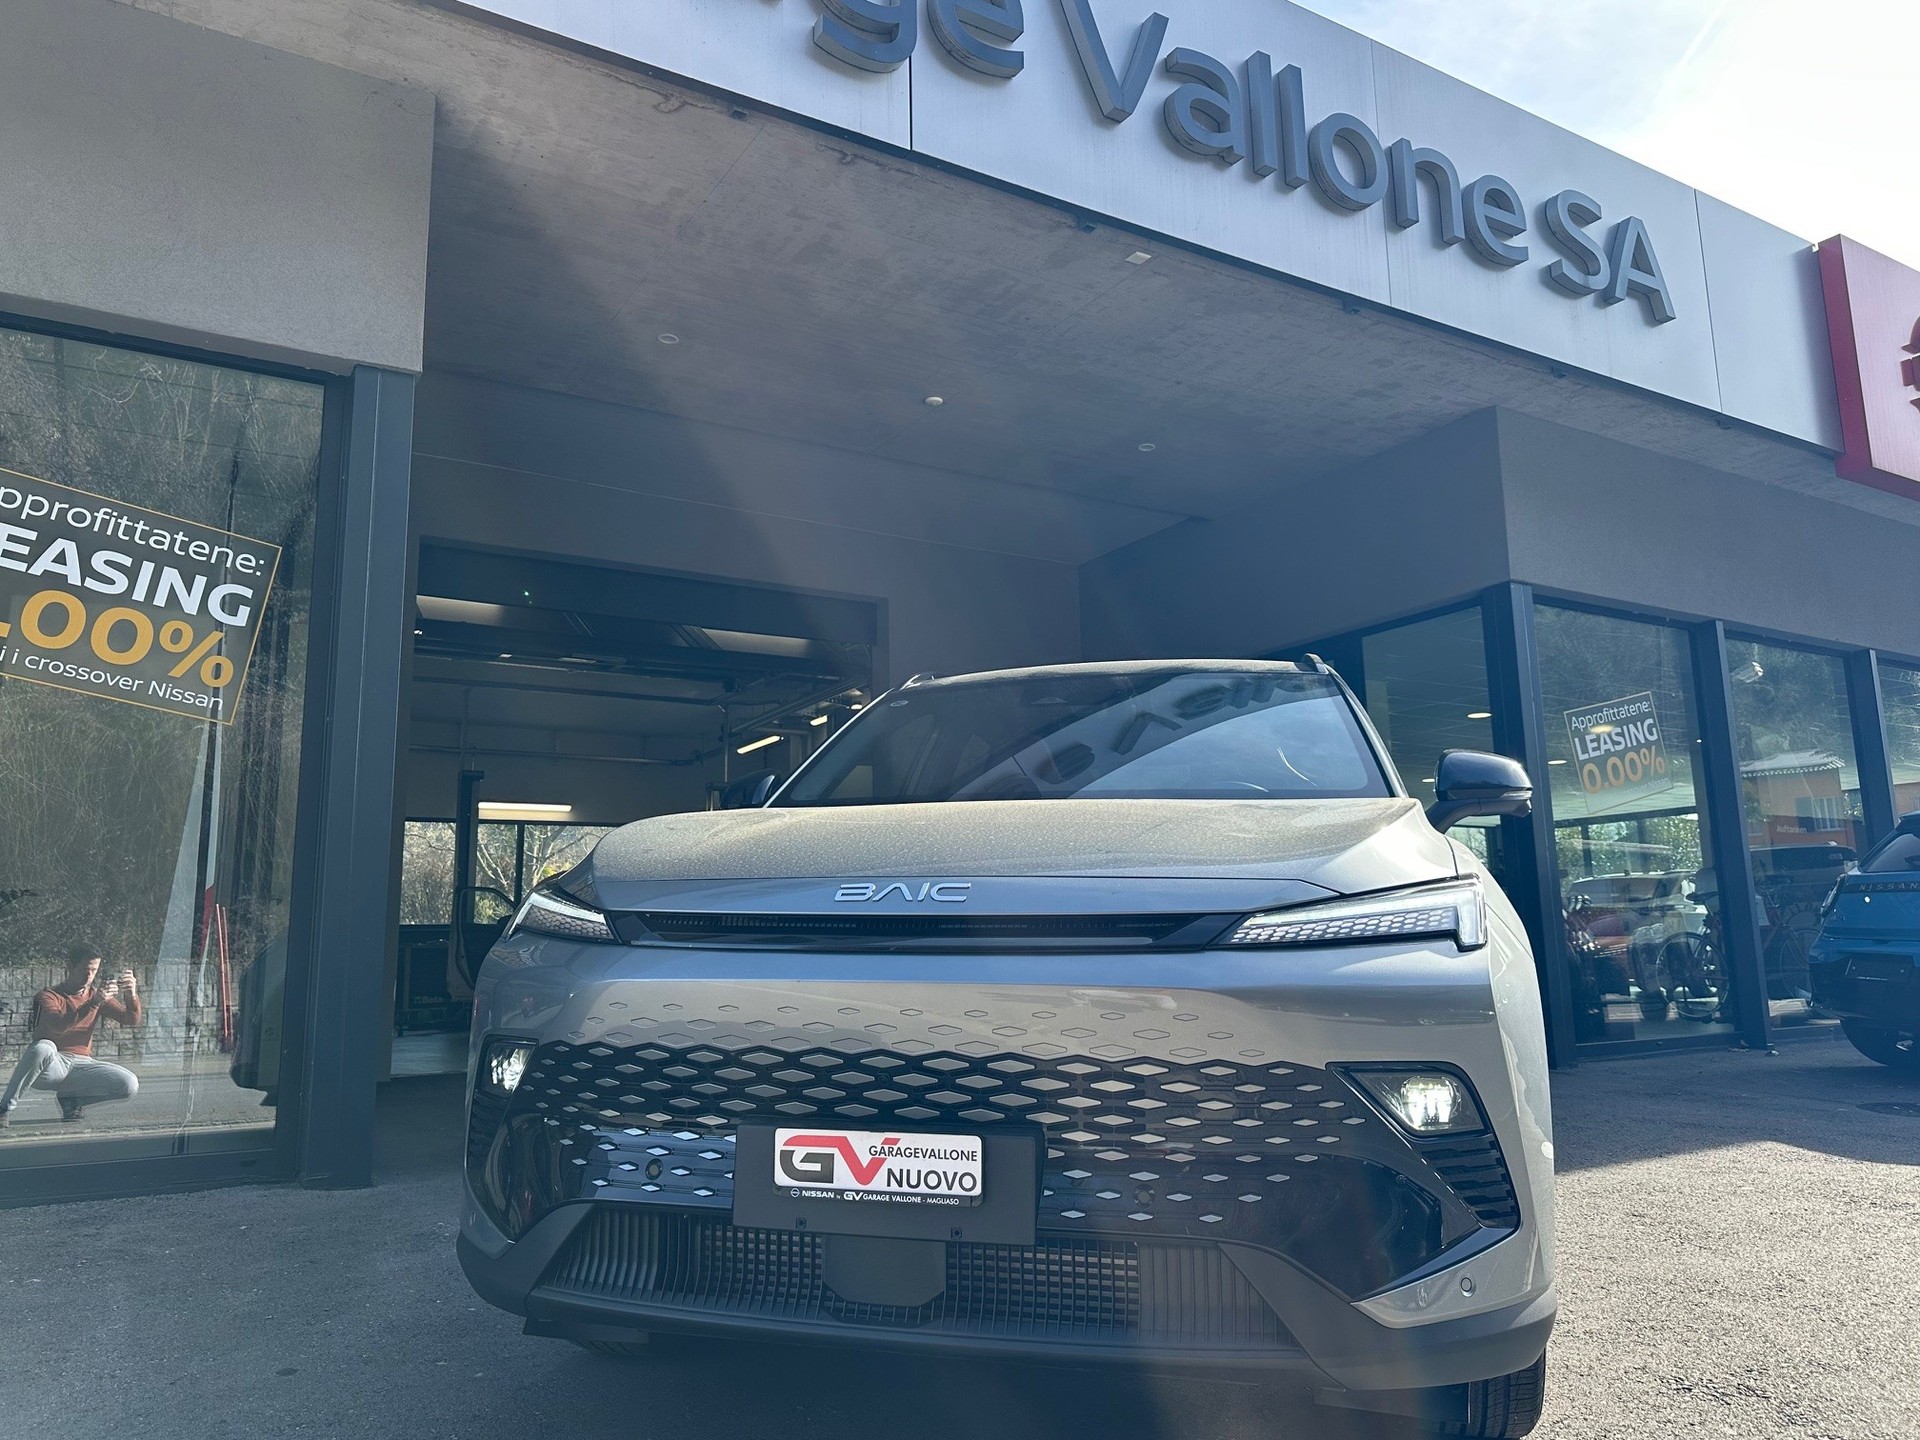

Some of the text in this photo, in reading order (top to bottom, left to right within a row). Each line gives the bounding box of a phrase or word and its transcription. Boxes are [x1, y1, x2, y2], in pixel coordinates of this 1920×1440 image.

[1058, 0, 1529, 267] Vallone
[1545, 189, 1676, 324] SA
[0, 522, 254, 627] EASING
[11, 648, 20, 664] i
[25, 655, 143, 692] crossover
[148, 680, 224, 711] Nissan
[1571, 701, 1652, 732] Approfittatene:
[1574, 718, 1659, 761] LEASING
[1582, 745, 1666, 795] 0.00%
[834, 882, 972, 902] BAIC
[1859, 882, 1918, 892] NISSAN
[780, 1135, 901, 1186] GV
[868, 1145, 978, 1162] GARAGEVALLONE
[802, 1190, 835, 1199] NISSAN
[843, 1191, 864, 1201] GV
[862, 1193, 890, 1202] GARAGE
[891, 1195, 922, 1204] VALLONE
[926, 1197, 960, 1206] MAGLIASO
[886, 1167, 977, 1193] NUOVO
